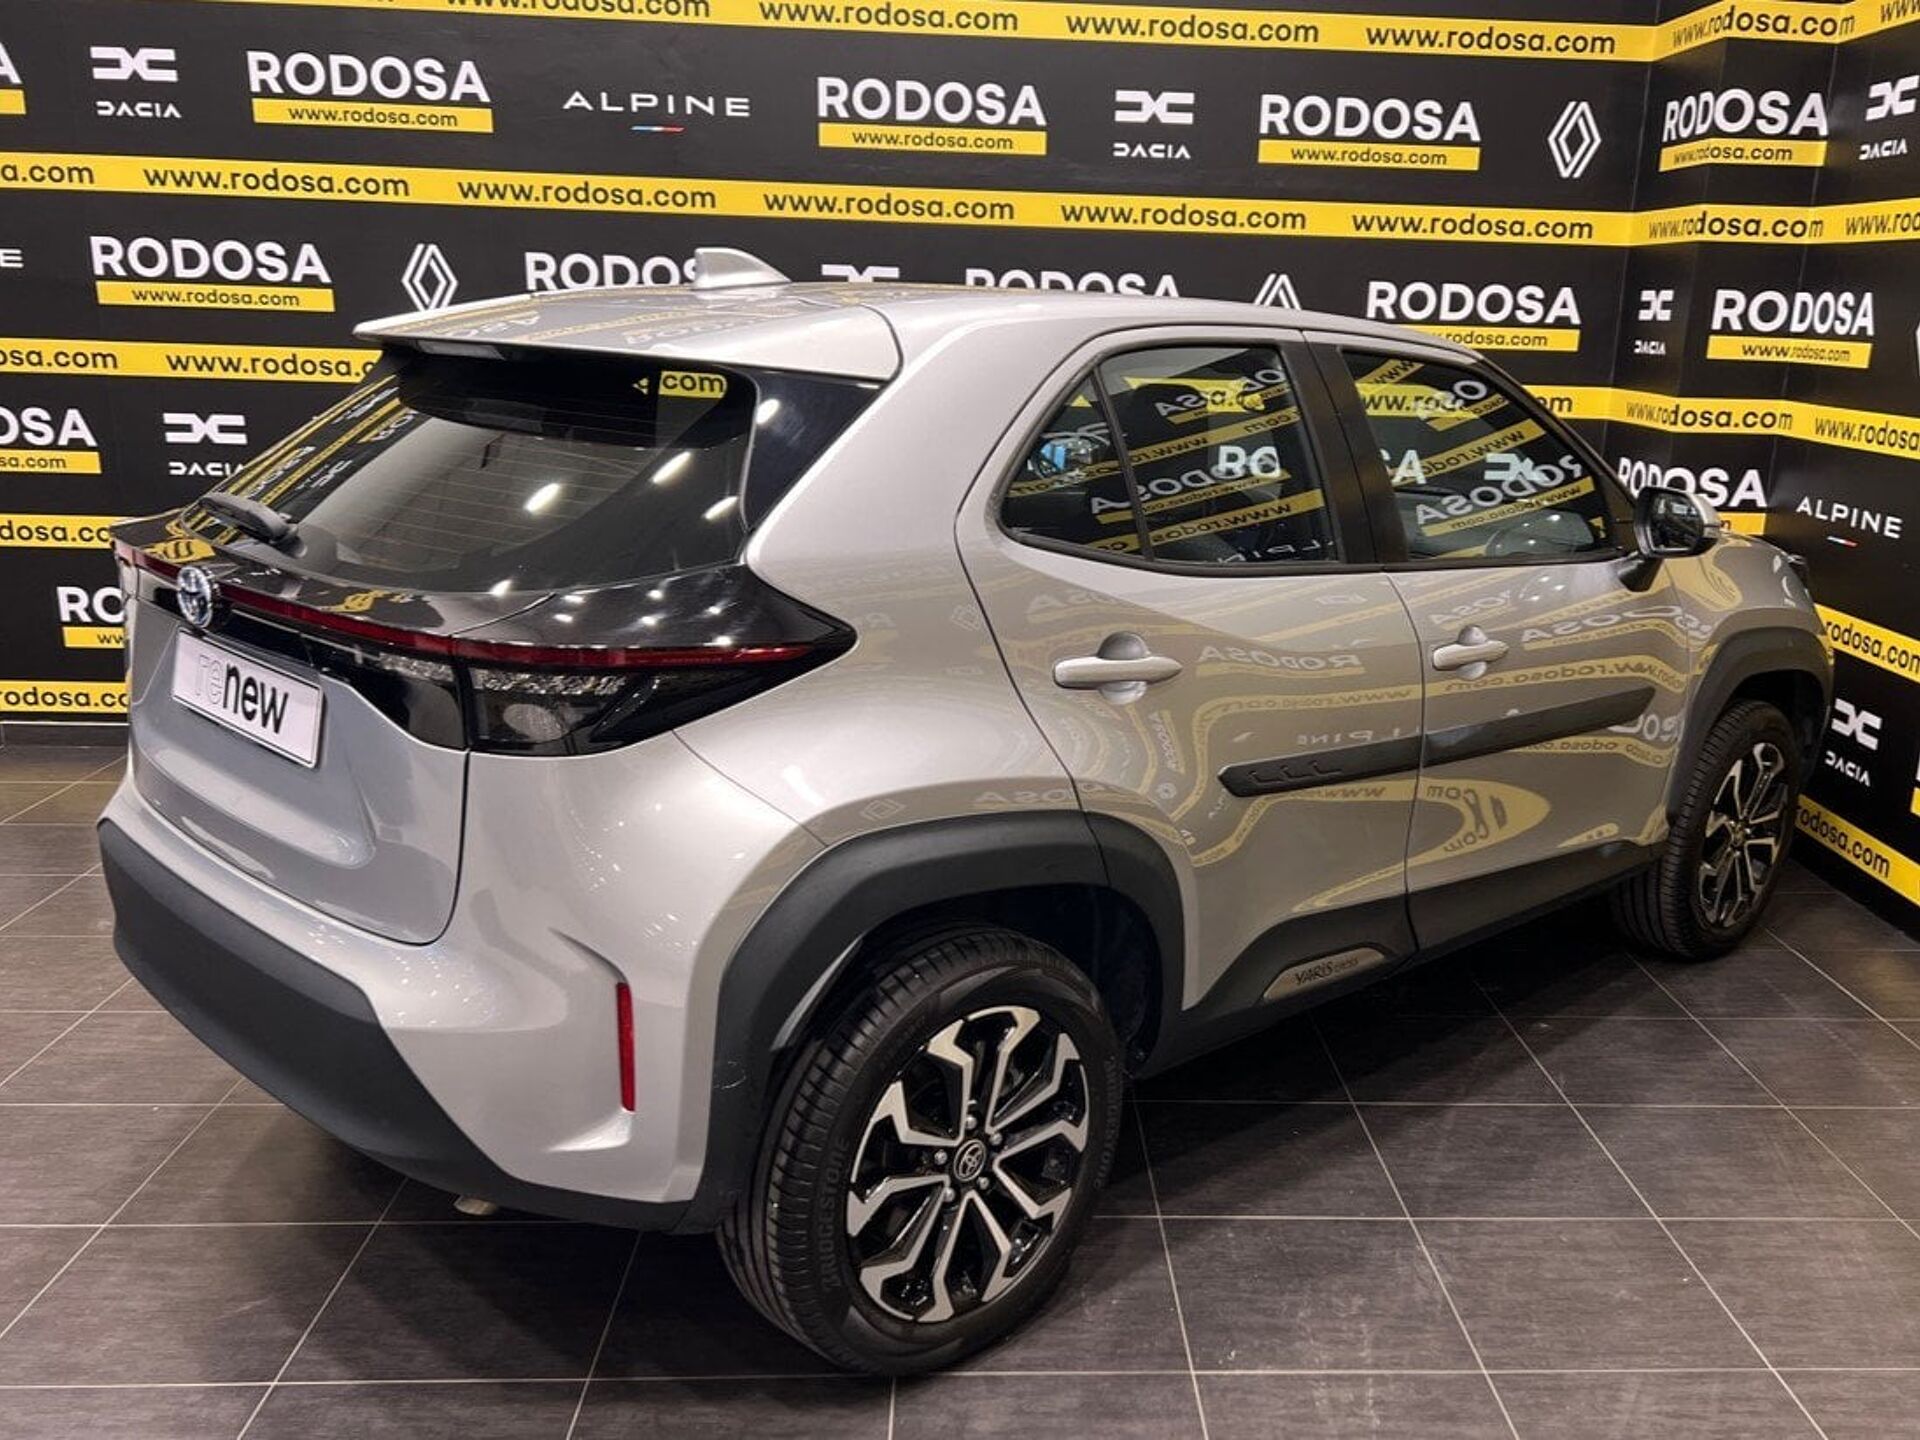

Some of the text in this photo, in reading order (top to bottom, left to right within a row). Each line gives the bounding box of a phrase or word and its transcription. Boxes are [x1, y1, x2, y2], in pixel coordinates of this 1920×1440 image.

[759, 1, 1019, 31] www.rodosa.com
[1066, 14, 1319, 43] www.rodosa.com
[1366, 26, 1616, 54] www.rodosa.com
[1673, 7, 1855, 48] www.rodosa.com
[247, 51, 491, 102] RODOSA
[95, 101, 182, 119] DACIA
[288, 108, 458, 127] www.rodosa.com
[563, 91, 750, 117] ALPINE
[818, 77, 1047, 126] RODOSA
[1260, 94, 1481, 142] RODOSA
[1663, 89, 1829, 143] RODOSA
[852, 131, 1013, 149] www.rodosa.com
[1112, 142, 1191, 160] DACIA
[1291, 147, 1447, 165] www.rodosa.com
[1859, 138, 1908, 161] DACIA
[144, 167, 409, 197] www.rodosa.com
[458, 181, 716, 209] www.rodosa.com
[763, 192, 1014, 220] www.rodosa.com
[1061, 202, 1306, 230] www.rodosa.com
[1352, 212, 1593, 239] www.rodosa.com
[1649, 211, 1824, 239] www.rodosa.com
[90, 236, 332, 284] RODOSA
[525, 251, 697, 291] RODO
[132, 287, 300, 307] www.rodosa.com
[1366, 281, 1582, 325] RODOSA
[1711, 289, 1875, 337] RODOSA
[1634, 340, 1666, 355] DACIA
[1742, 343, 1850, 361] www.rodosa.com
[166, 353, 376, 378] www.rodosa.c
[1626, 402, 1793, 431] www.rodosa.com
[0, 519, 111, 543] dosa.co
[1796, 497, 1903, 539] ALPINE
[1826, 619, 1920, 675] rodosa.com
[0, 686, 129, 709] odosa.co
[1825, 750, 1872, 787] DACIA
[1797, 804, 1891, 879] rodosa.com
